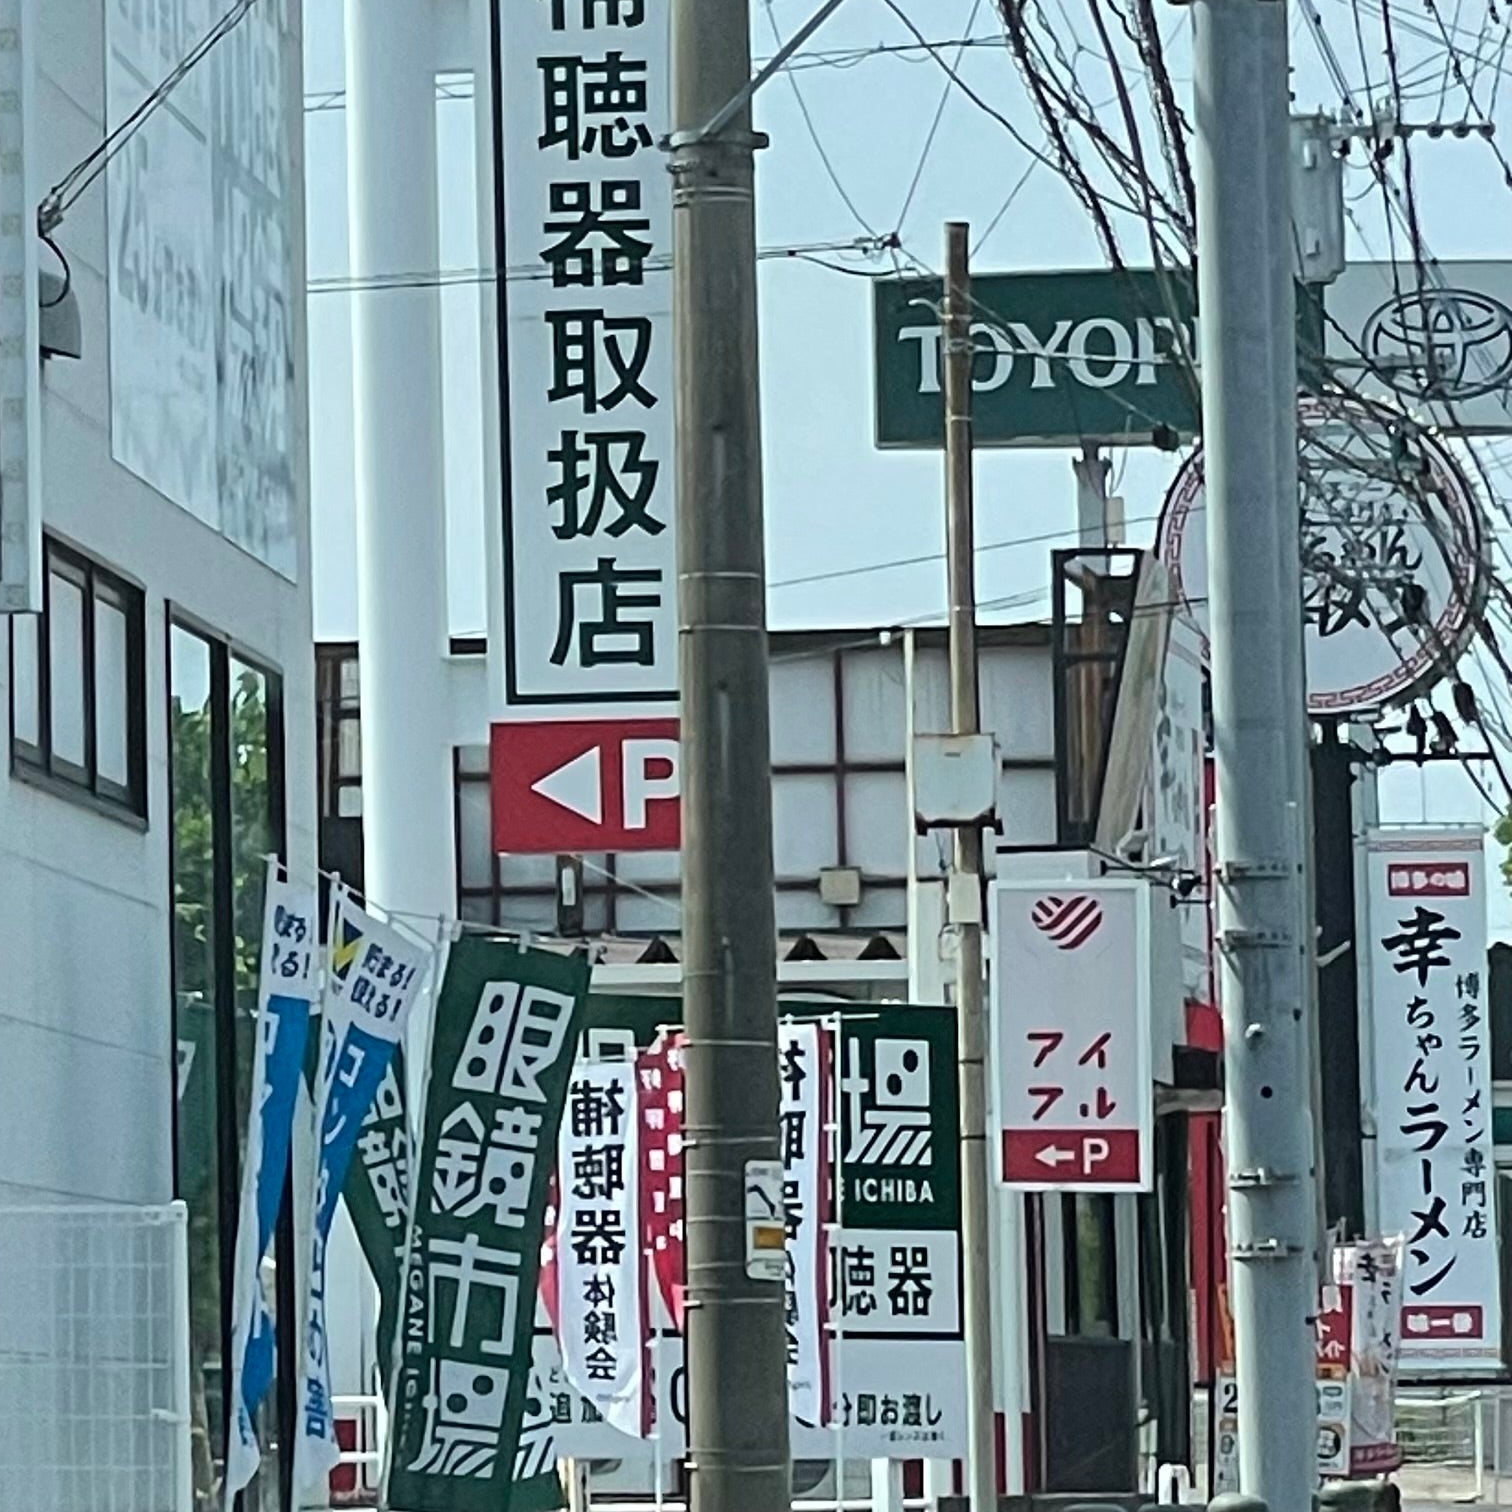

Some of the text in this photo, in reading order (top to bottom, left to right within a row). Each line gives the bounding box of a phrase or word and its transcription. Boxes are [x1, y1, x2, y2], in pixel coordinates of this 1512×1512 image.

[898, 316, 1200, 393] TOYOP
[620, 739, 681, 830] P
[1027, 1032, 1112, 1069] アイ
[1028, 1087, 1116, 1121] フル
[1381, 906, 1462, 1296] 幸ちゃんラーメン
[1455, 972, 1487, 1238] 博多ラーメン専門店
[1083, 1138, 1110, 1175] P
[854, 1178, 935, 1203] ICHIBA
